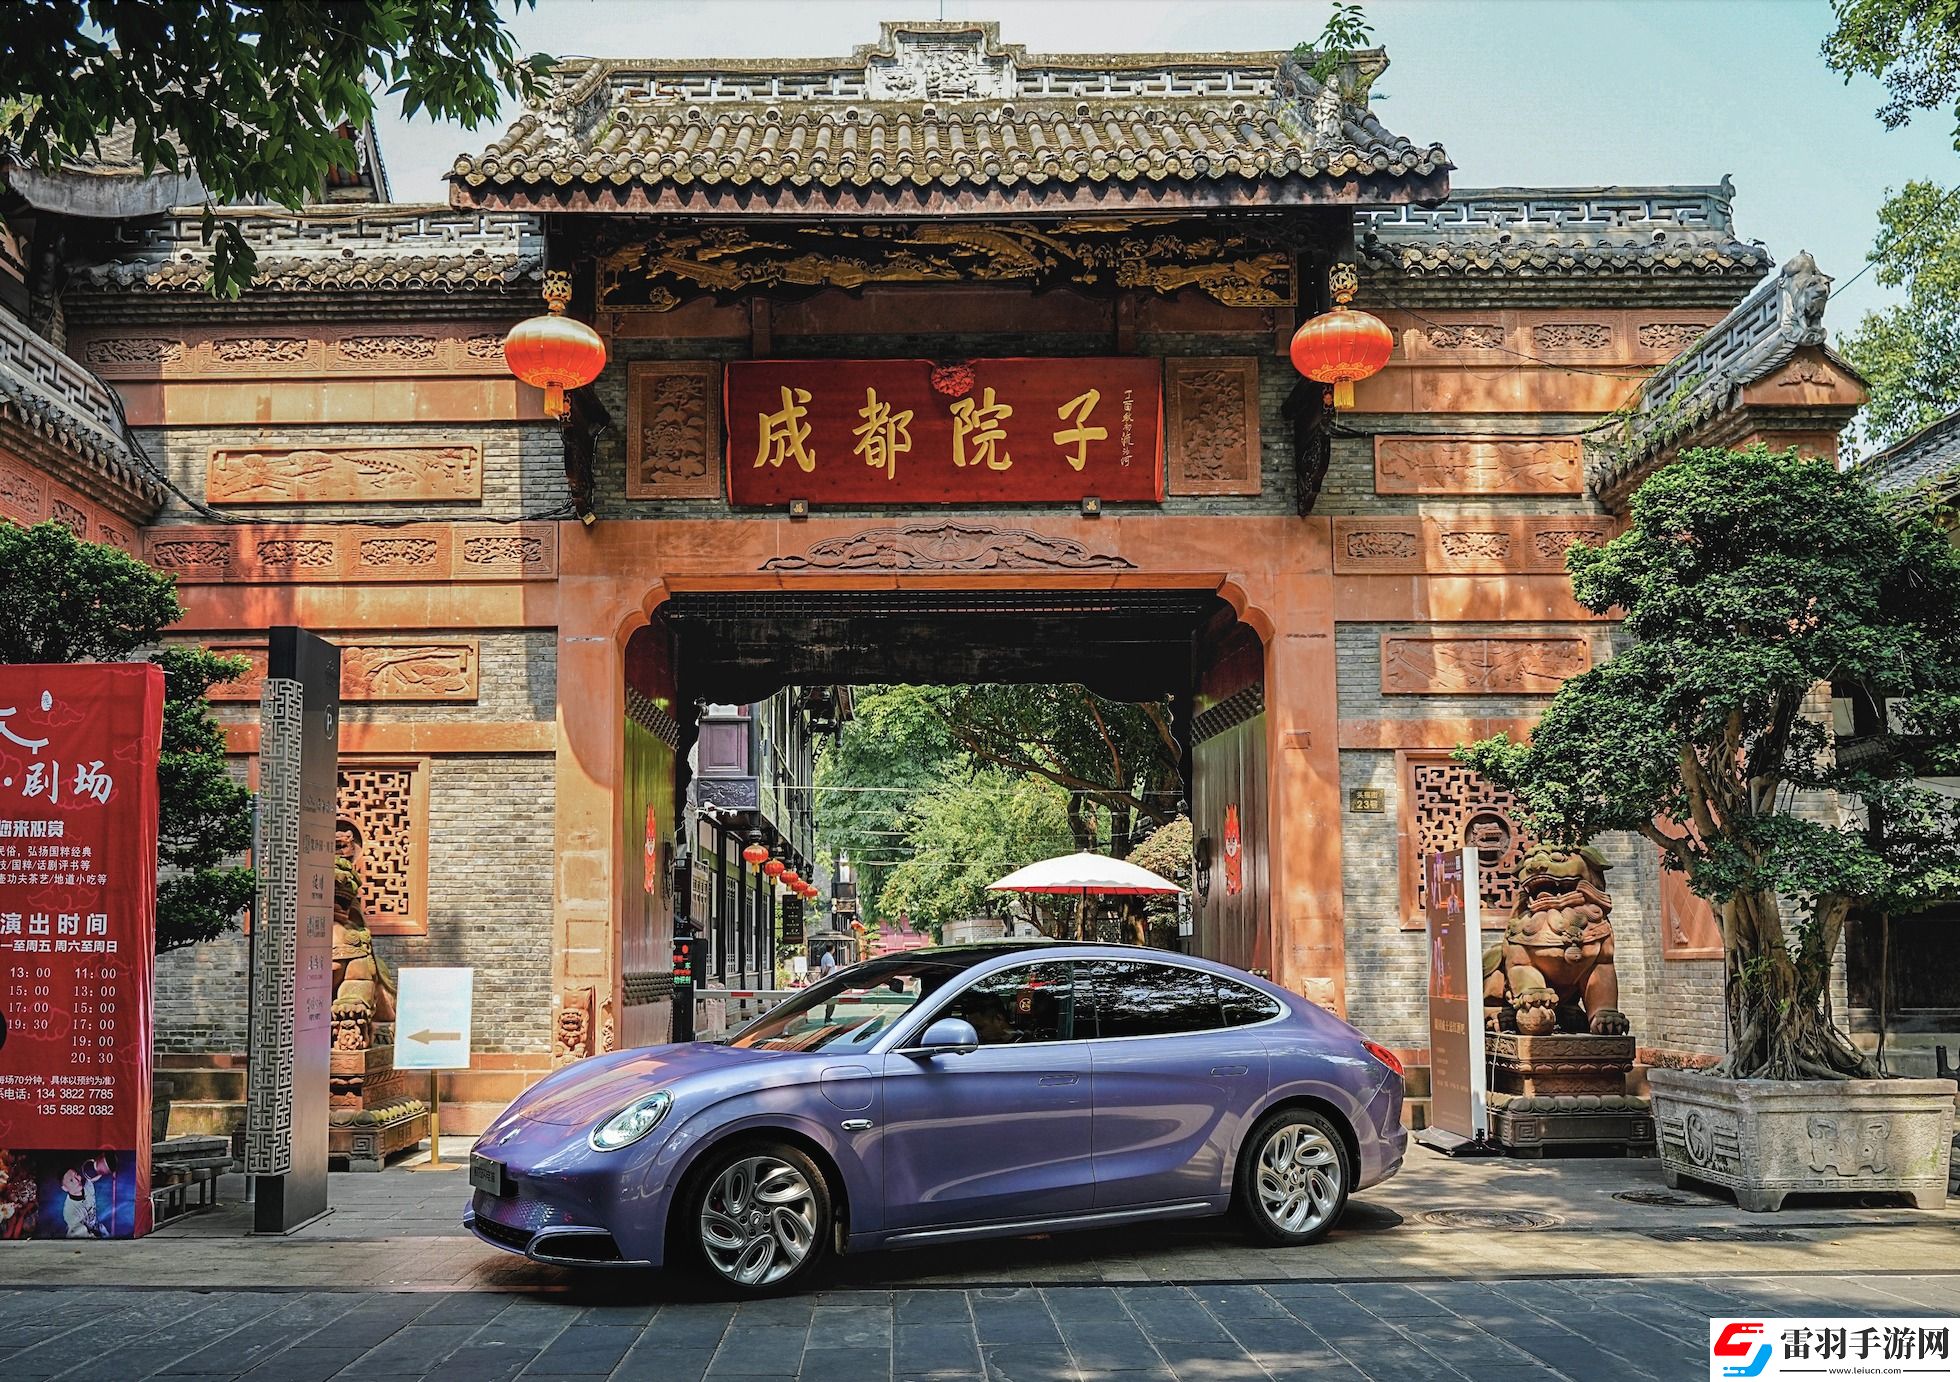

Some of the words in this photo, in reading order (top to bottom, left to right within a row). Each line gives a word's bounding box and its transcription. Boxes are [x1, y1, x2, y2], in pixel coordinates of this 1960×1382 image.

[752, 385, 1108, 481] 成都院子
[0, 912, 108, 936] 演出时间
[0, 940, 51, 953] 一至周五
[54, 940, 118, 953] 周六至周日
[36, 1089, 56, 1099] 134
[59, 1089, 85, 1099] 3822
[88, 1089, 114, 1099] 7785
[36, 1104, 57, 1115] 135
[59, 1105, 85, 1115] 5882
[88, 1105, 114, 1116] 0382
